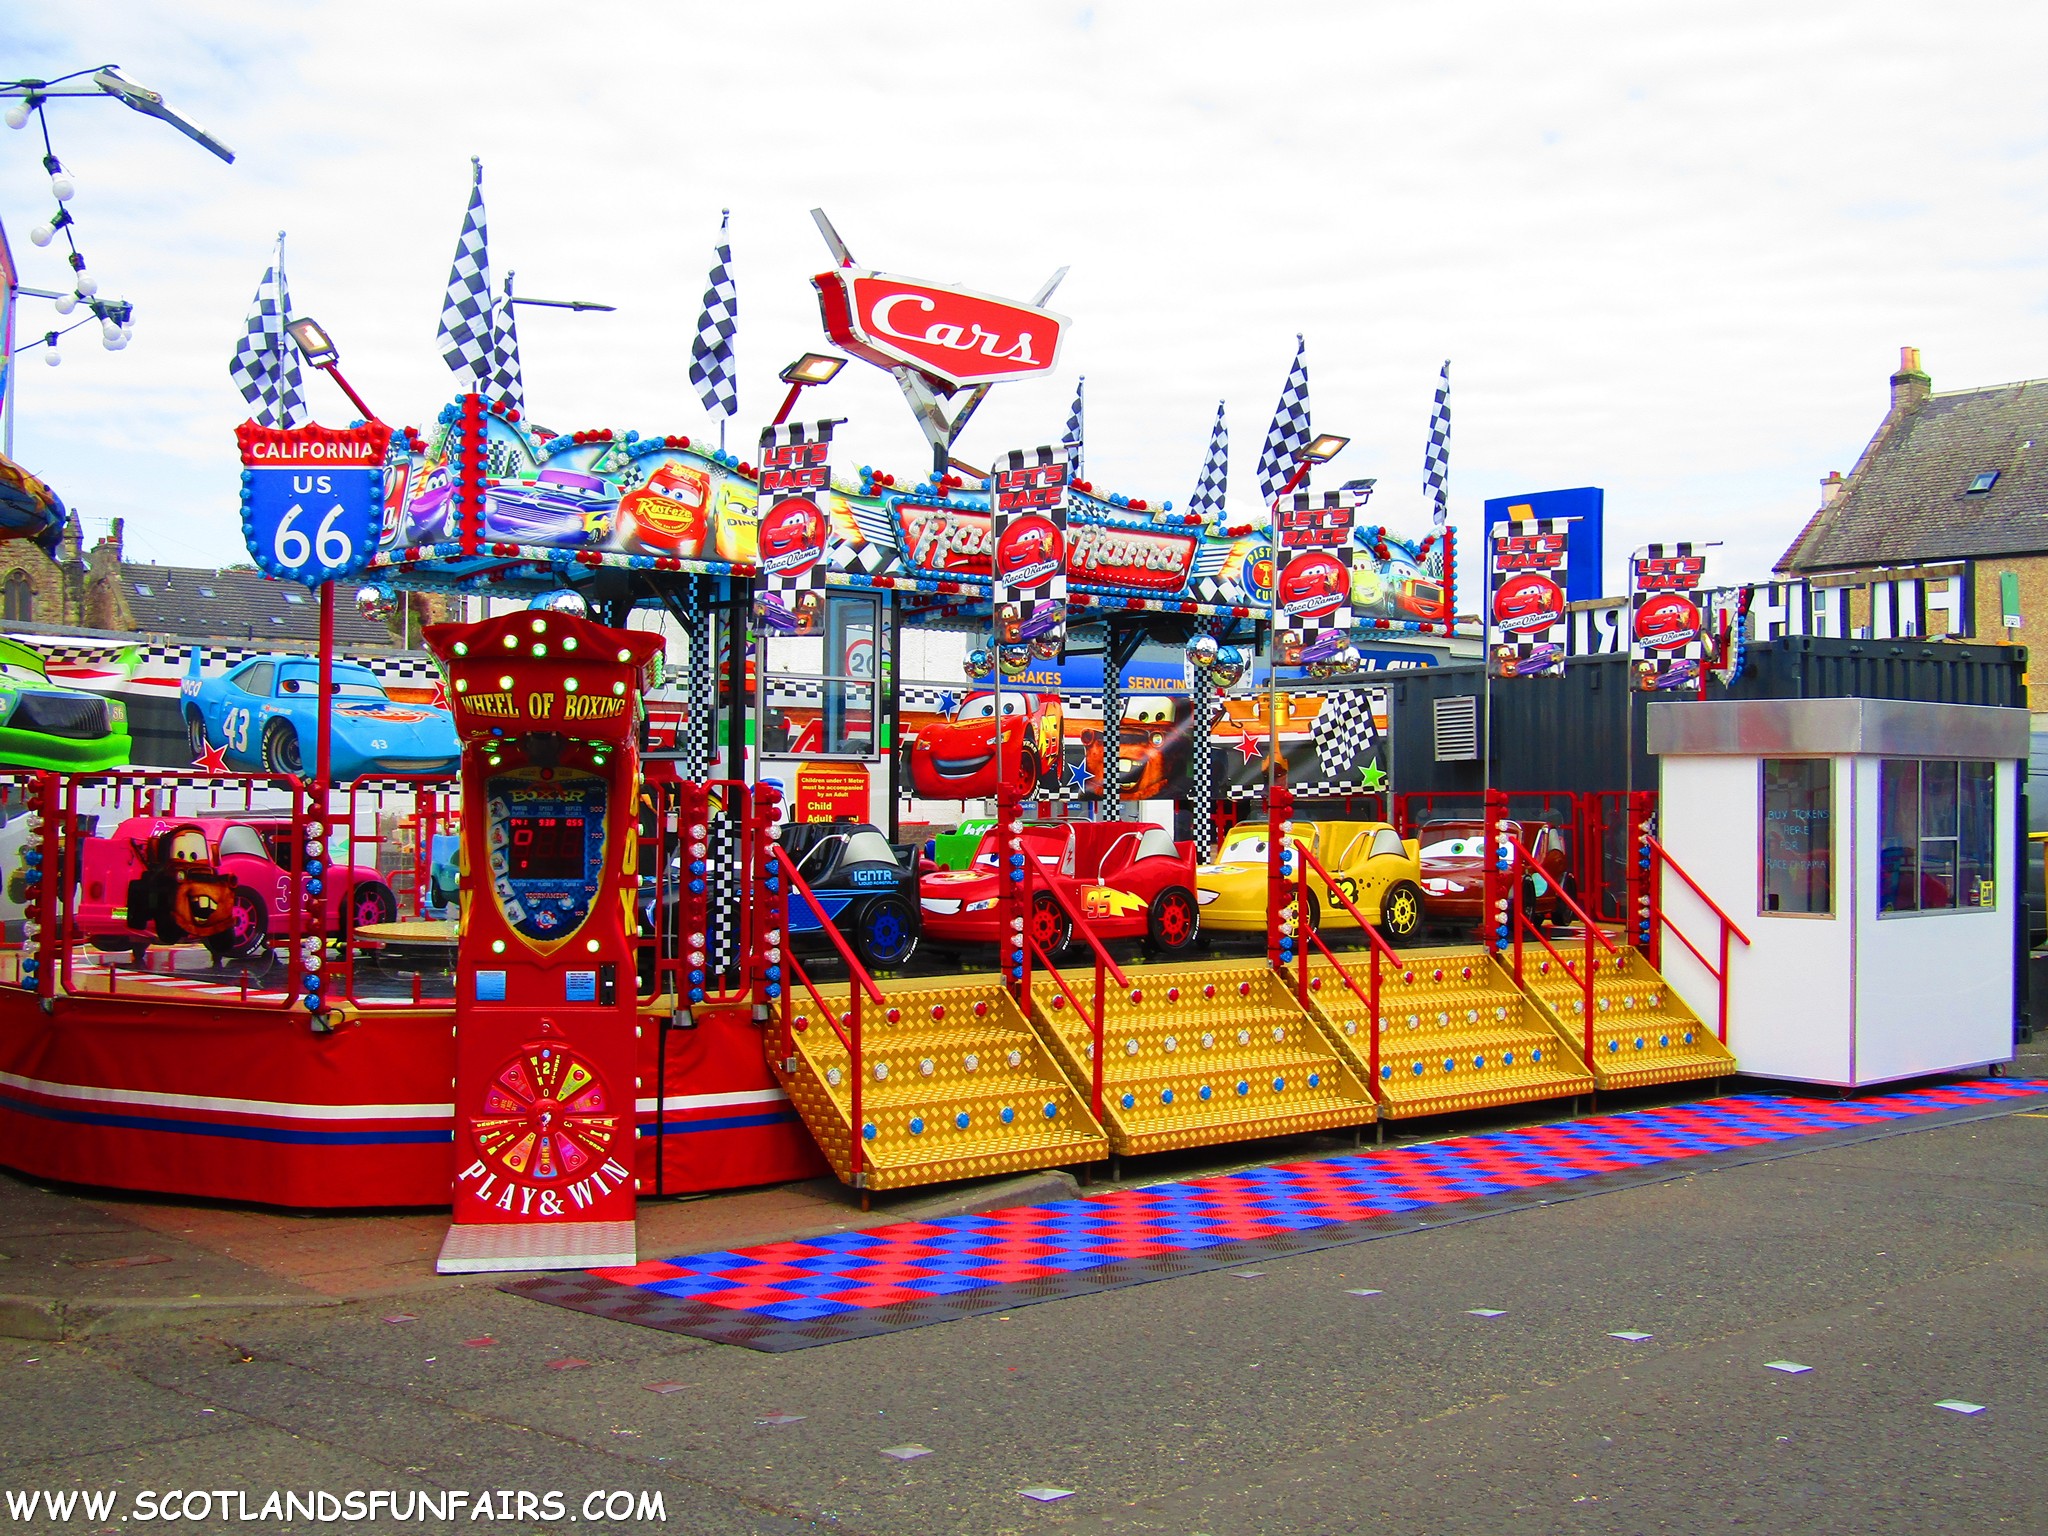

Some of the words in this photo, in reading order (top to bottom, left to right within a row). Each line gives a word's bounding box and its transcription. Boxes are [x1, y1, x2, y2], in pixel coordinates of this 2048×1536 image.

[871, 293, 1040, 365] Cars
[252, 442, 373, 459] CALIFORNIA
[764, 438, 828, 467] LET'S
[293, 475, 332, 494] US
[763, 467, 826, 490] RACE
[999, 463, 1063, 489] LET'S
[999, 486, 1062, 510] RACE
[1283, 506, 1350, 527] LET'S
[274, 503, 352, 568] 66
[1282, 527, 1349, 546] RACE
[1497, 532, 1563, 551] LET'S
[1247, 547, 1272, 565] PIST
[1497, 552, 1563, 569] RACE
[1638, 555, 1701, 573] LET'S
[1637, 574, 1700, 590] RACE
[1256, 589, 1273, 601] CU
[1008, 670, 1062, 685] BRAKES
[1128, 676, 1186, 689] SERVICIN
[461, 692, 520, 719] WHEEL
[529, 692, 554, 719] OF
[564, 694, 625, 720] BOXING
[223, 707, 250, 753] 43
[371, 739, 388, 750] 43
[807, 801, 832, 810] Child
[1768, 810, 1788, 820] BUY
[1792, 809, 1829, 819] TOKENS
[807, 814, 833, 823] Adult
[1784, 825, 1809, 835] HERE
[853, 870, 892, 881] IGNTR
[1086, 890, 1111, 918] 95
[530, 1056, 544, 1086] WIN
[542, 1062, 551, 1075] 2
[458, 1159, 537, 1214] PLAY
[540, 1190, 564, 1216] &
[567, 1157, 629, 1209] WIN
